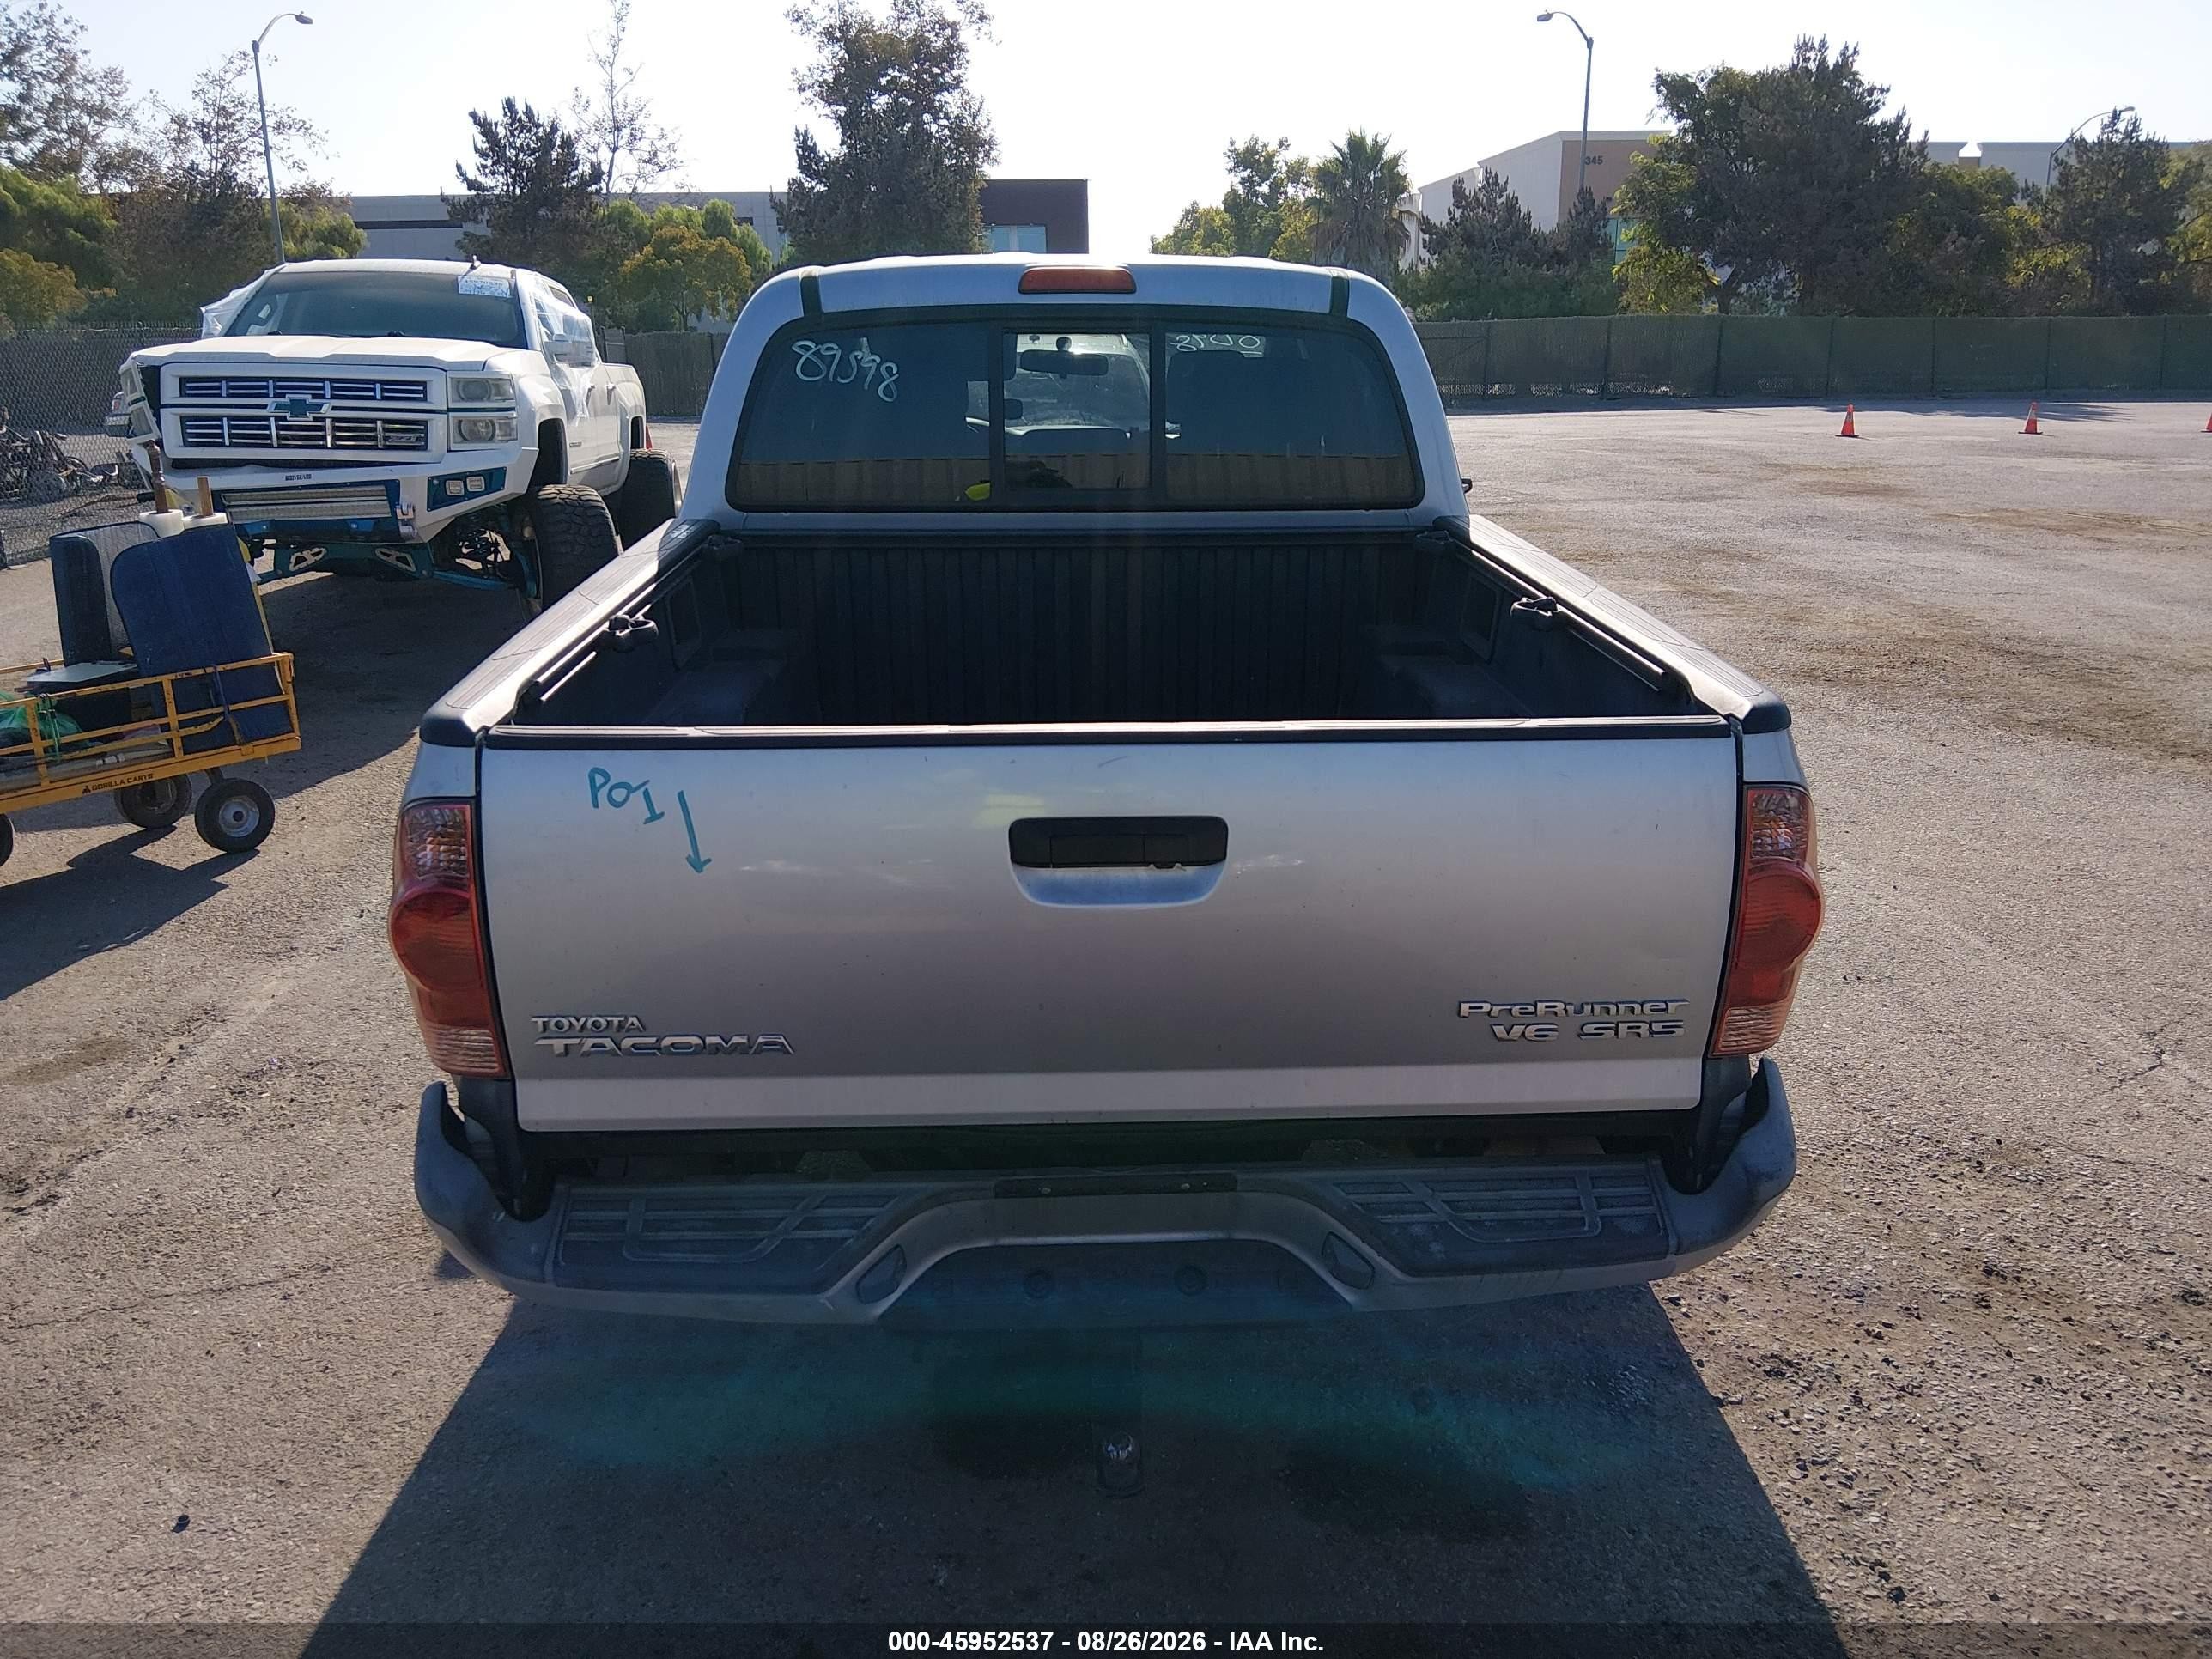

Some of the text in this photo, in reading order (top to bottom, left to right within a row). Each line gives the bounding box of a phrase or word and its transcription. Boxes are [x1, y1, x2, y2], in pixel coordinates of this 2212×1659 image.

[1584, 155, 1603, 165] 345
[91, 774, 154, 791] GORILLA CARTS
[1459, 999, 1691, 1018] PreRunner
[530, 1016, 646, 1032] TOYOTA
[1491, 1019, 1685, 1042] V6 SR5
[534, 1034, 795, 1057] TACOMA
